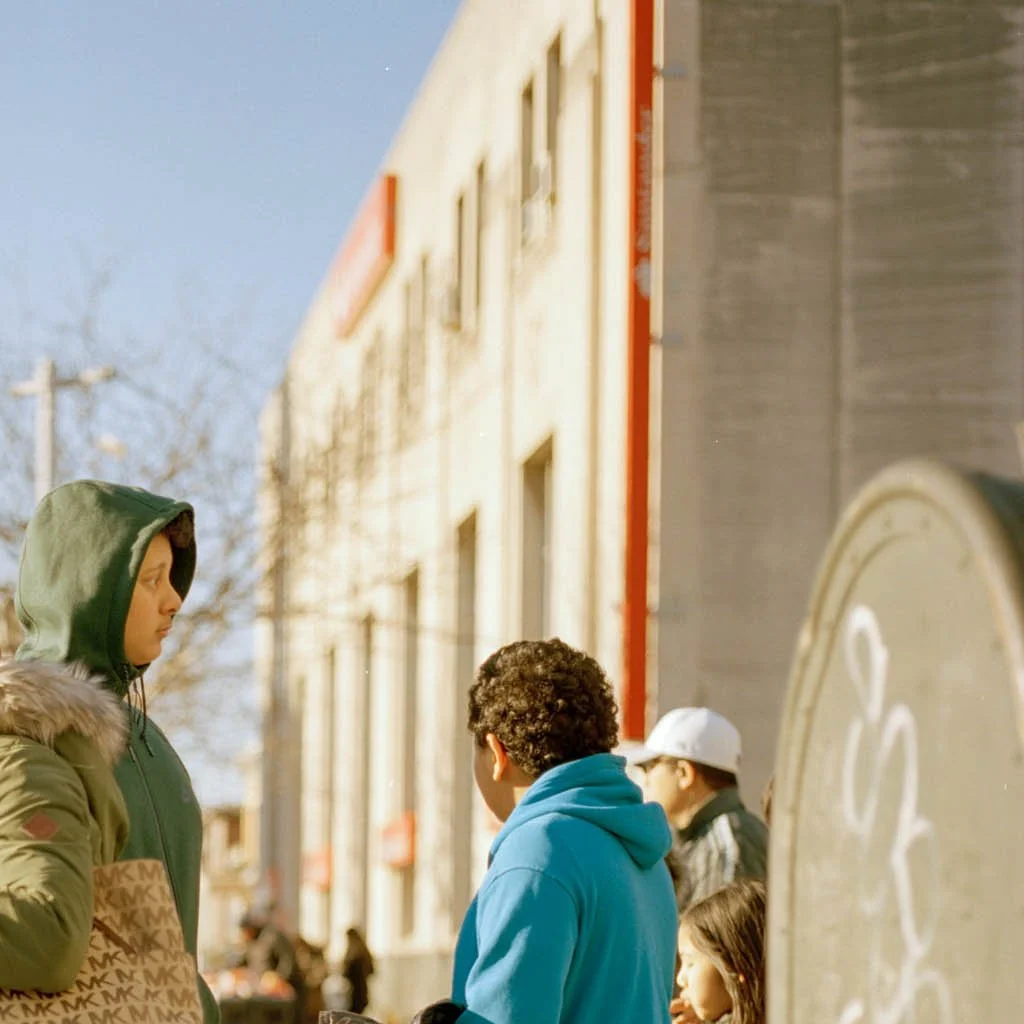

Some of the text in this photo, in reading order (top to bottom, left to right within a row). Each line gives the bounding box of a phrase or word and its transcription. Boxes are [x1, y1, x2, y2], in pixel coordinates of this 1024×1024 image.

[88, 952, 123, 972] MK
[75, 971, 115, 992] MK
[21, 1002, 60, 1018] MK
[59, 992, 99, 1013] MK
[102, 986, 138, 1005] MK
